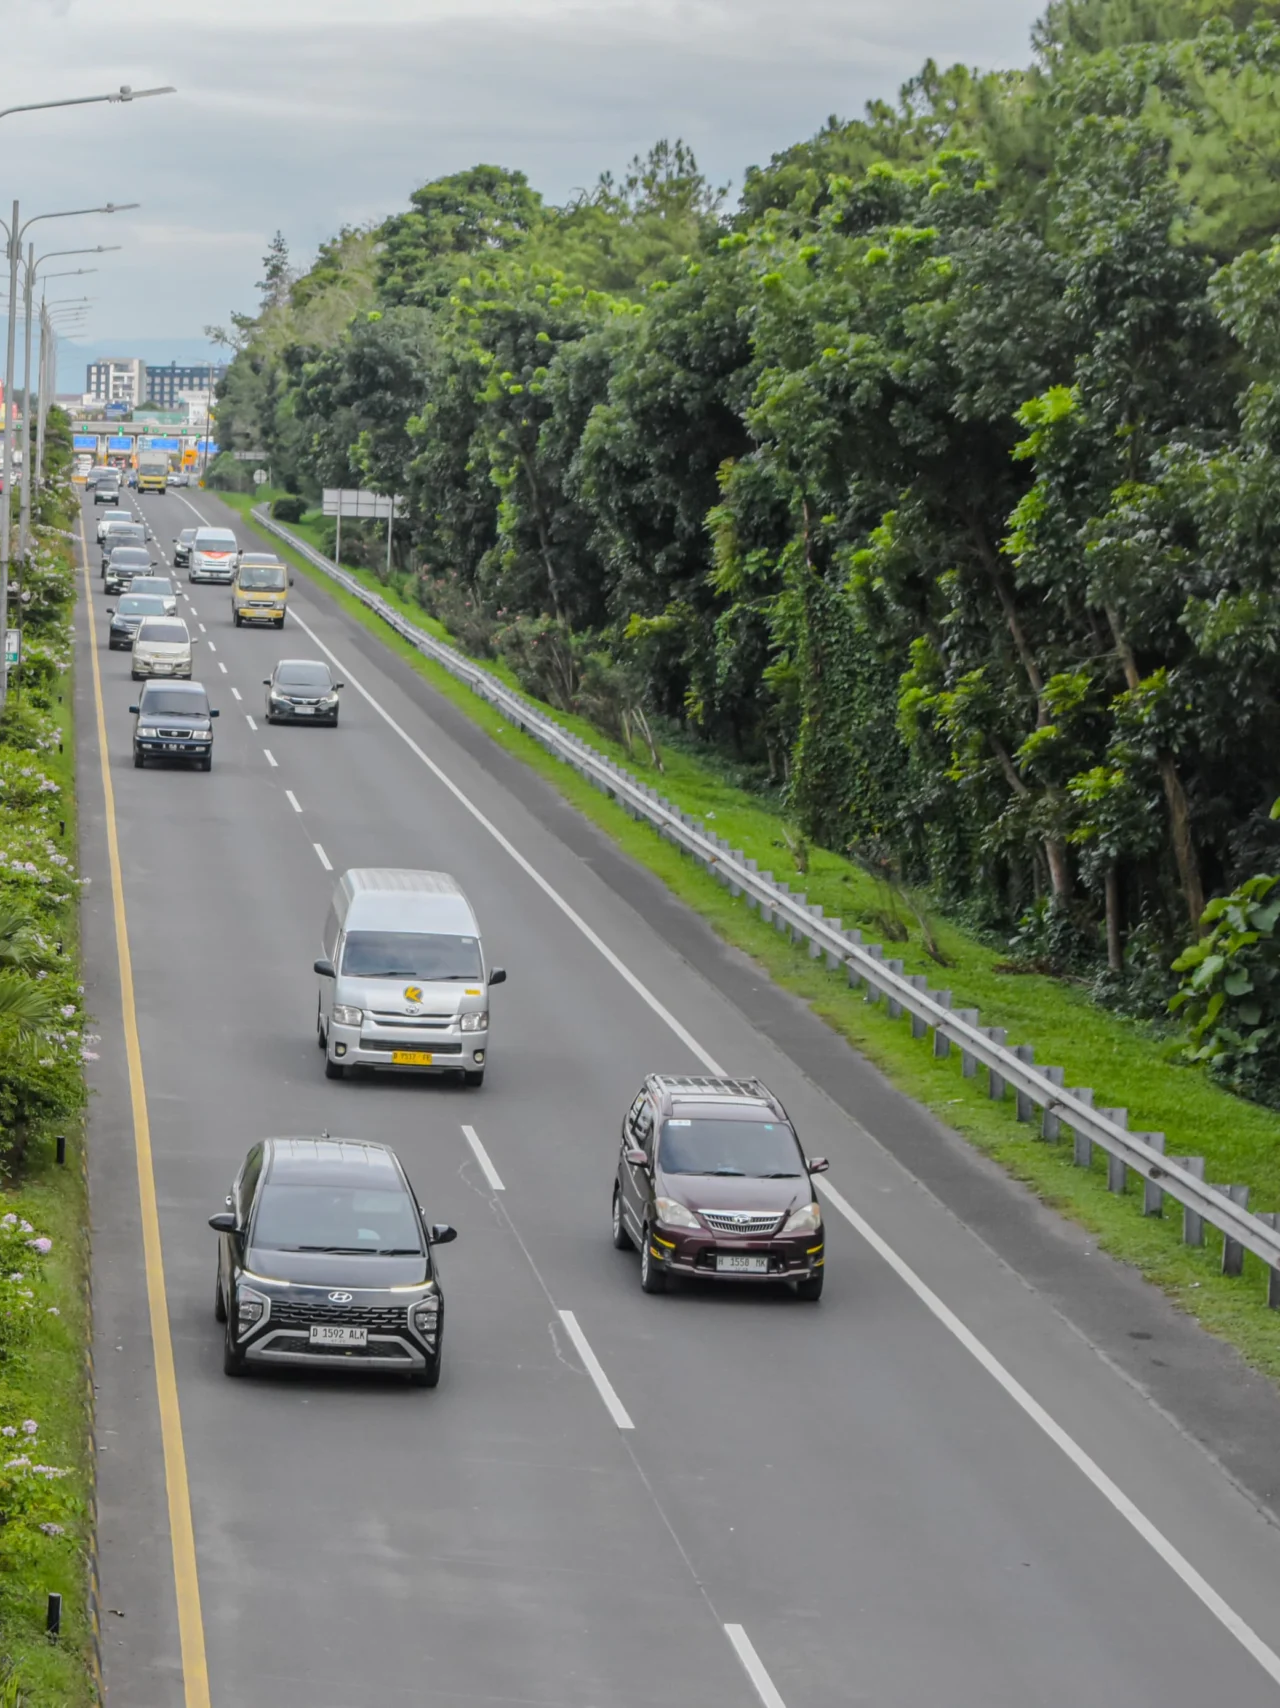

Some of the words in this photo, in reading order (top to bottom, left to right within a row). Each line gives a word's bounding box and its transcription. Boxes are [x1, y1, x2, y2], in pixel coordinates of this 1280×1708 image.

[312, 1327, 318, 1338] D
[322, 1328, 345, 1339] 1592
[348, 1329, 365, 1340] ALK
